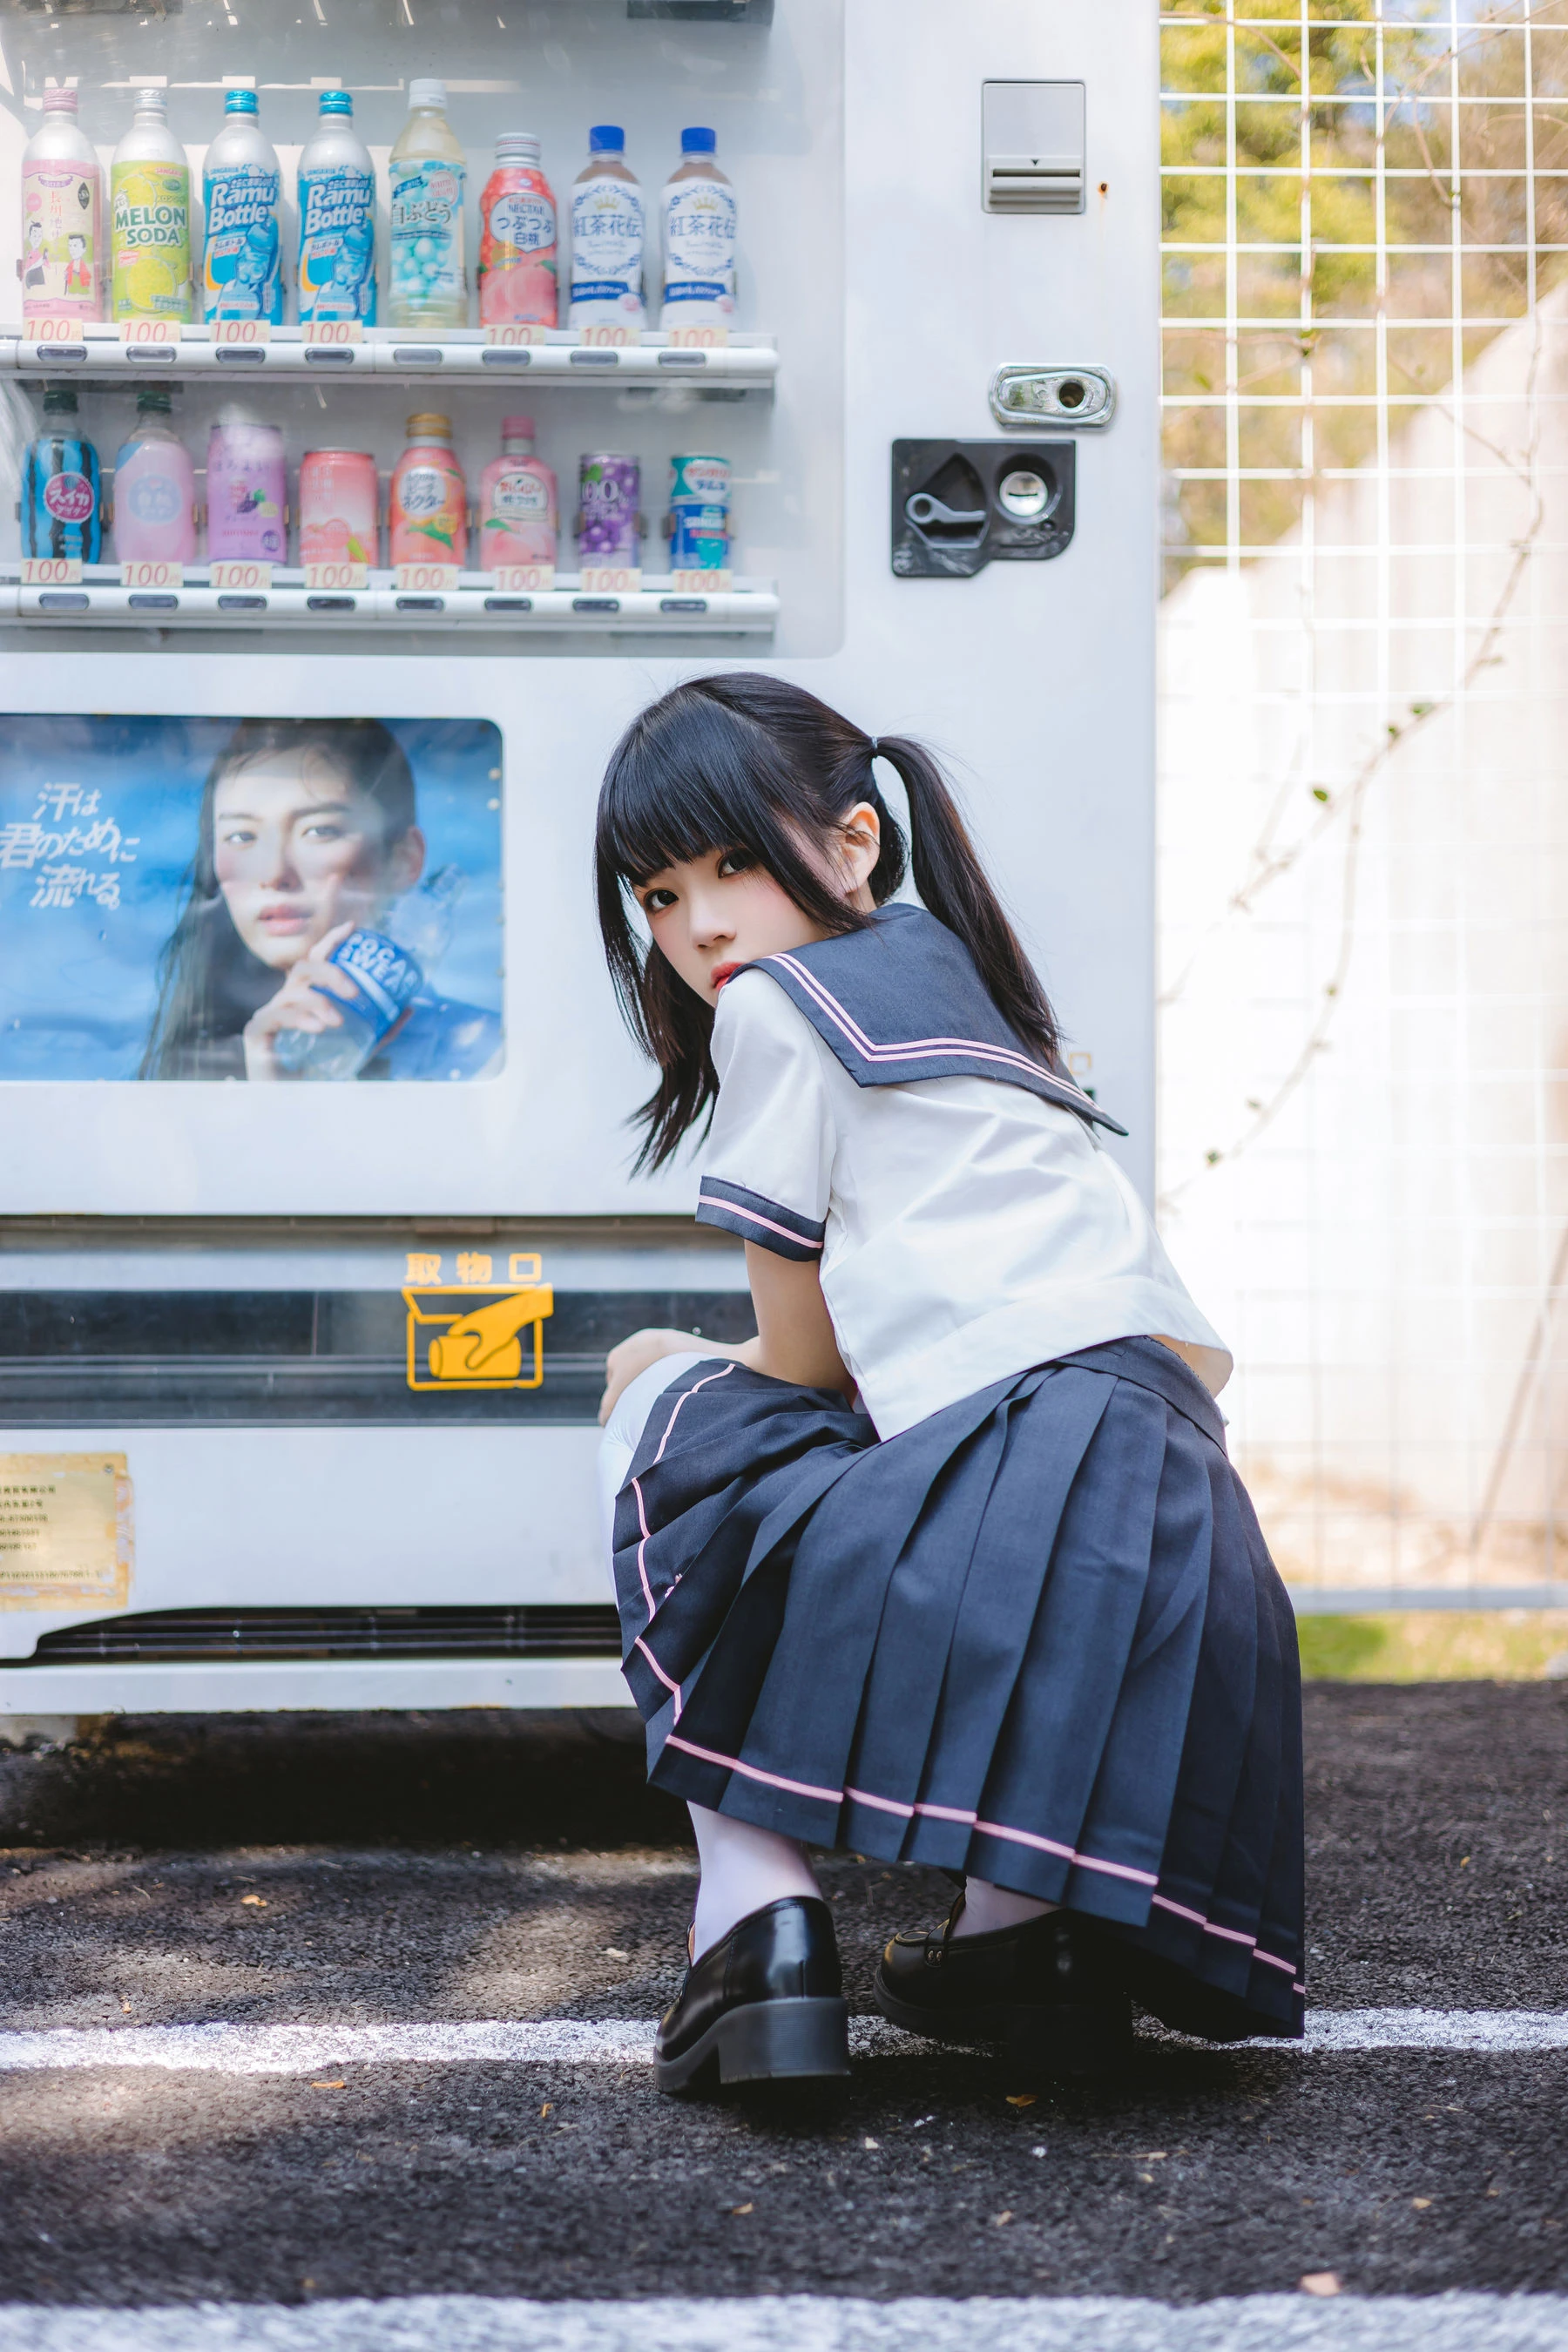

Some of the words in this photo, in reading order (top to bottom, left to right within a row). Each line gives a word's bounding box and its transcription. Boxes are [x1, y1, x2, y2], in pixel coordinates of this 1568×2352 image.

[211, 183, 274, 209] Ramu
[307, 184, 370, 210] Ramu
[116, 206, 186, 230] MELON
[208, 203, 268, 234] Bottle
[305, 205, 364, 235] Bottle
[390, 201, 451, 224] 白ぶどう
[497, 216, 552, 233] つぶつぶ
[127, 228, 179, 245] SODA
[49, 488, 91, 506] スイカ
[31, 781, 103, 822] 汗は
[0, 816, 140, 868] 君のために
[405, 1252, 542, 1285] 取物口
